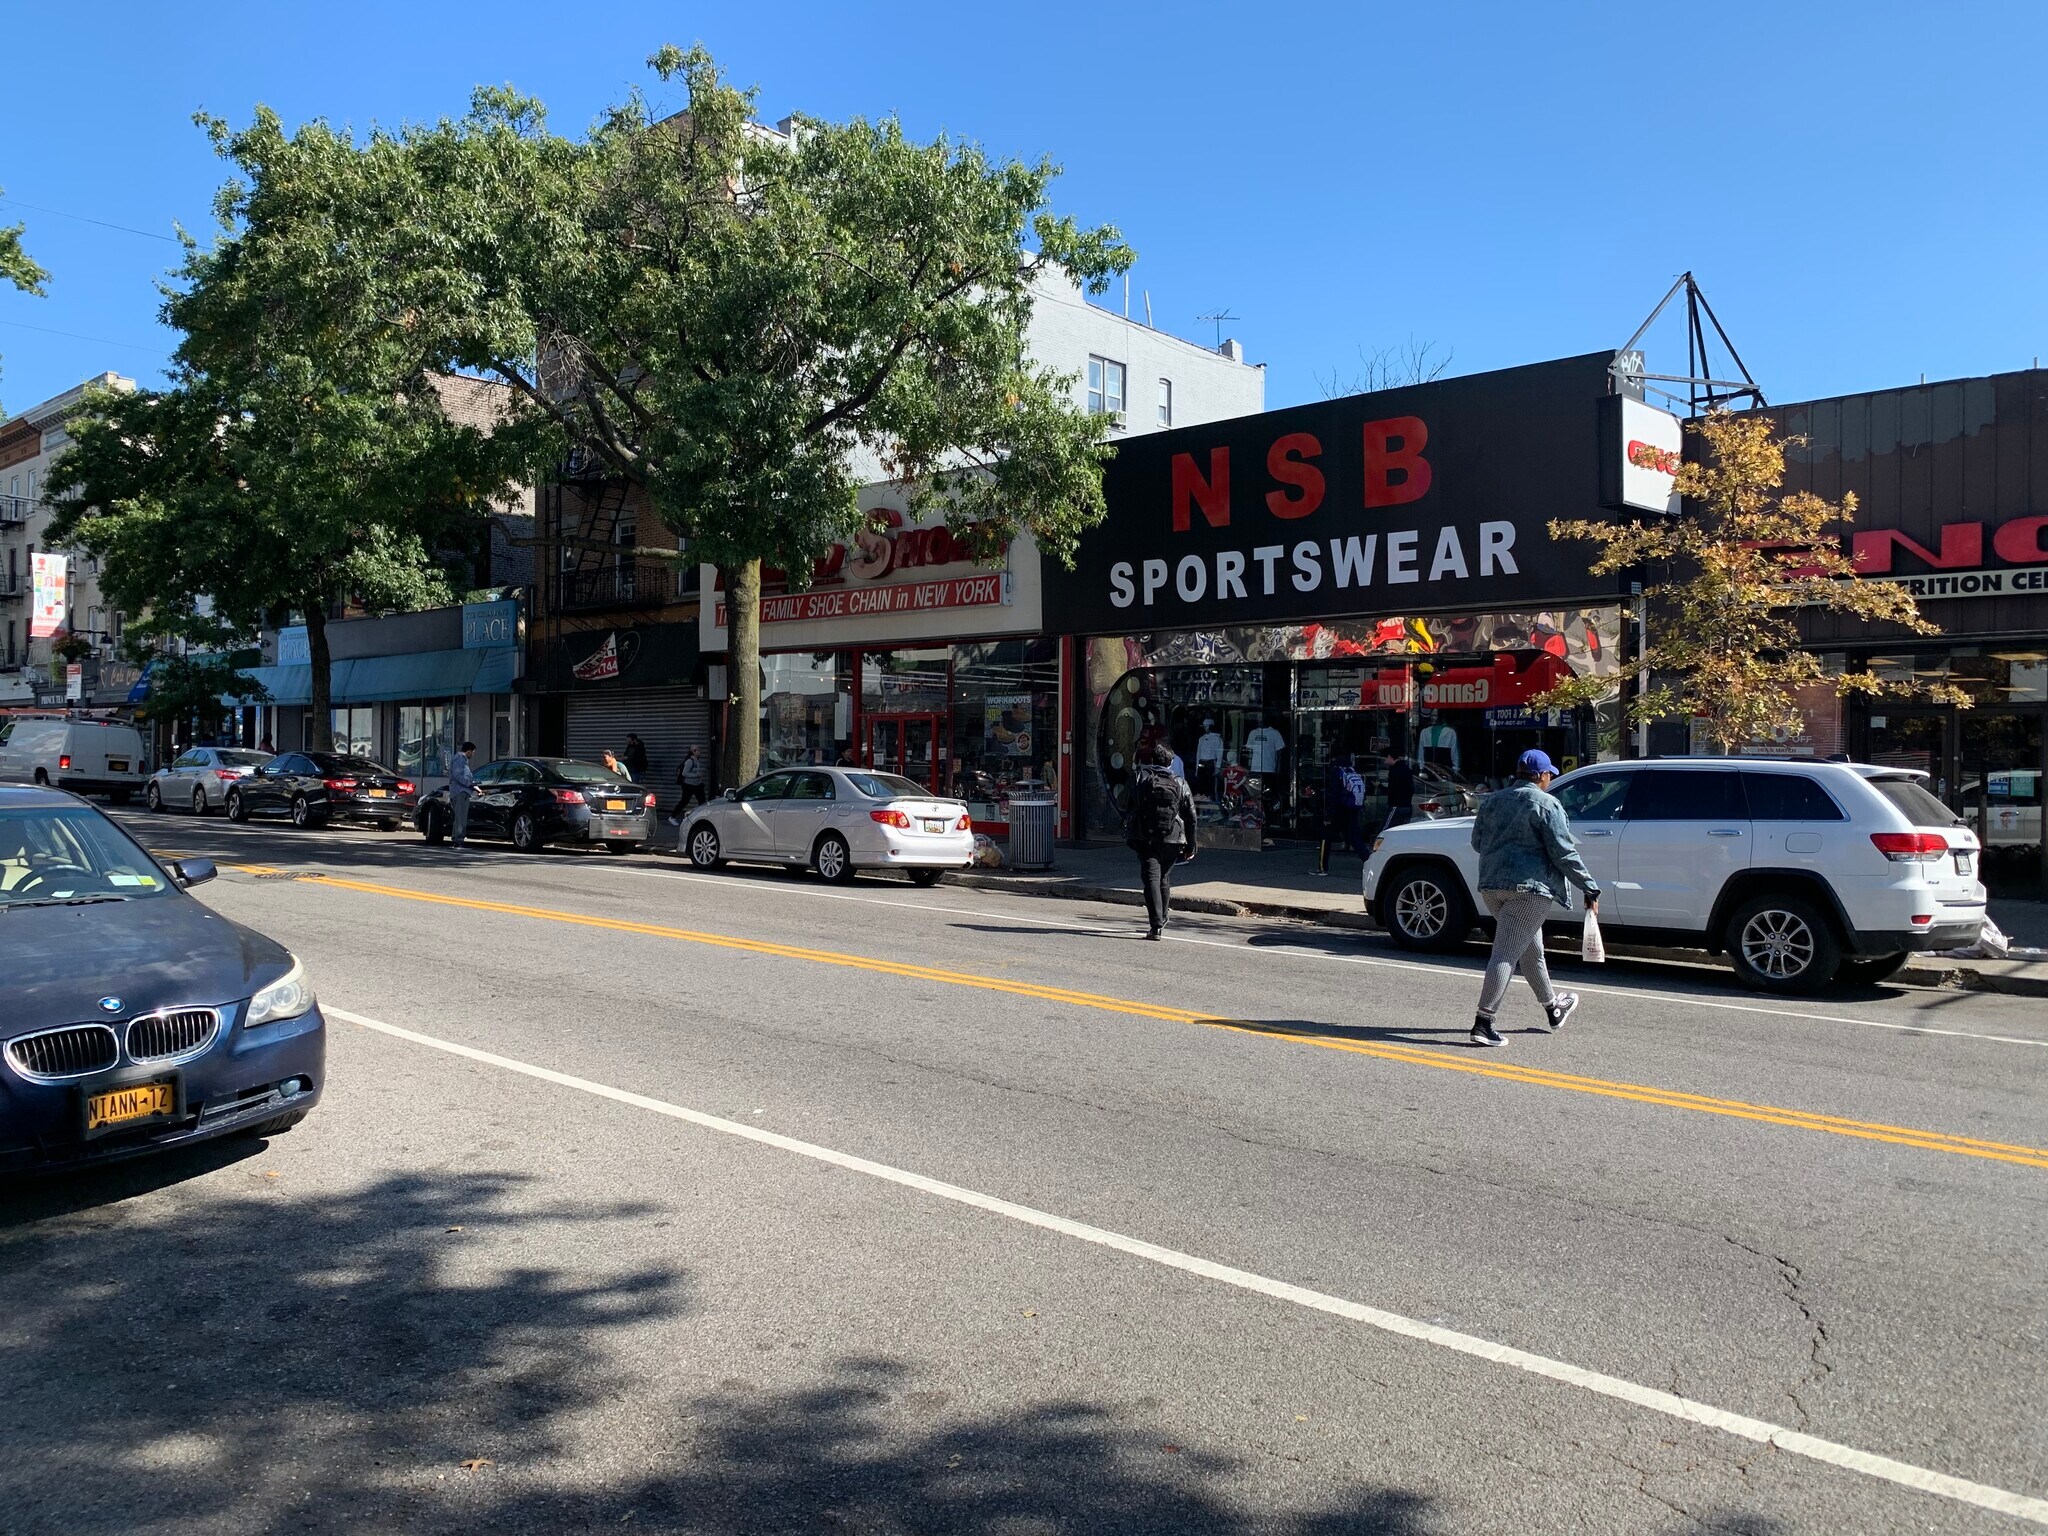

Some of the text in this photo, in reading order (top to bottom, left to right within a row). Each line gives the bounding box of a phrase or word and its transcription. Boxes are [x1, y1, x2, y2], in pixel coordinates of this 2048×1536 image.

[1109, 520, 1520, 608] SPORTSWEAR
[762, 578, 997, 621] FAMILY SHOE CHAIN in NEW YORK
[466, 619, 508, 642] PLACE
[986, 695, 1031, 705] WORKBOOTS
[1792, 735, 1812, 744] OFF
